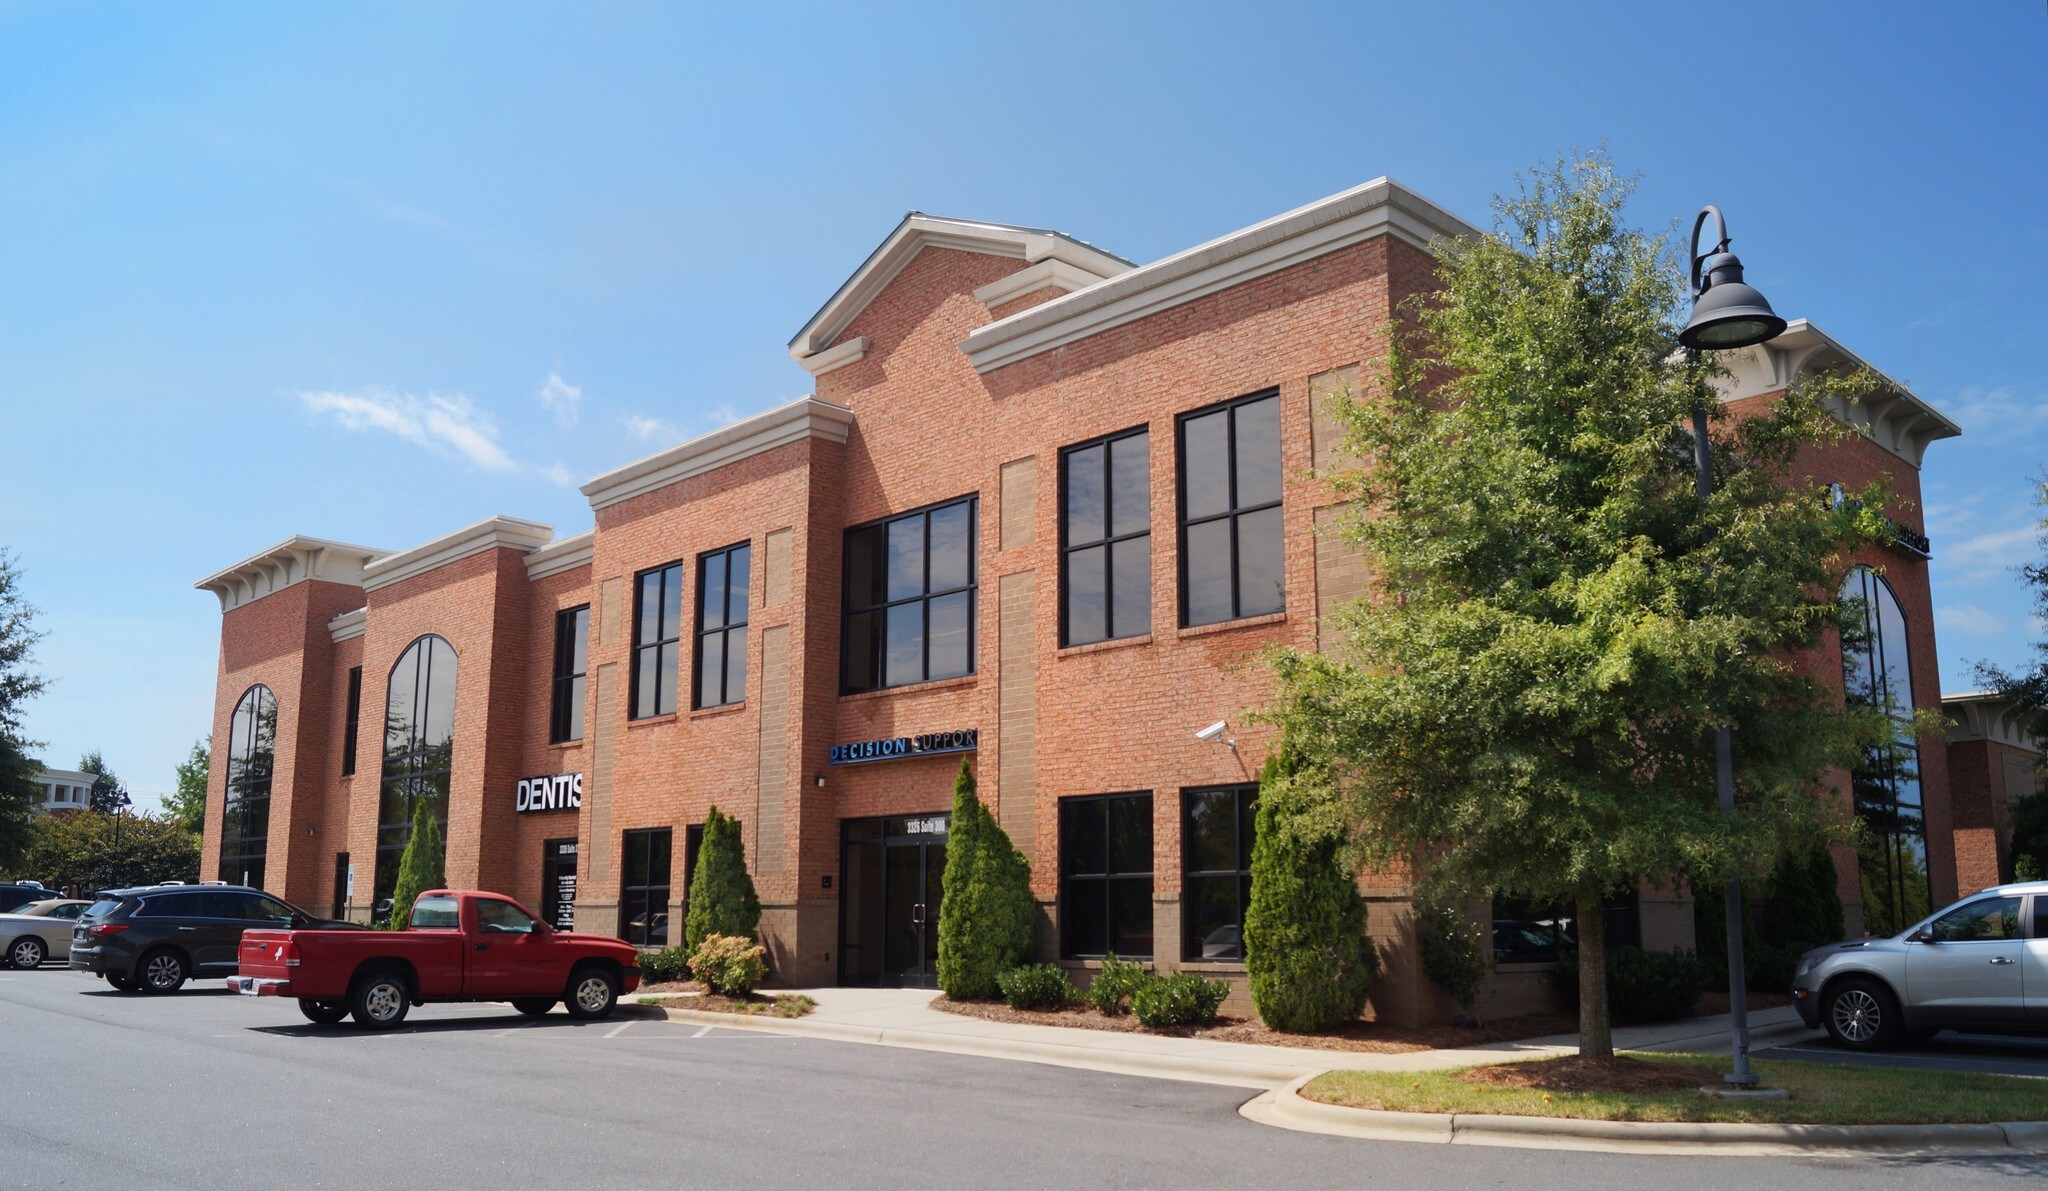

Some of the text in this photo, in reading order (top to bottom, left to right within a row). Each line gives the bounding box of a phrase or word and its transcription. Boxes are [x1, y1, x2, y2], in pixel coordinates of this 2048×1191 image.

[829, 738, 906, 760] DECISION
[516, 773, 582, 811] DENTIS
[920, 820, 934, 832] Suite
